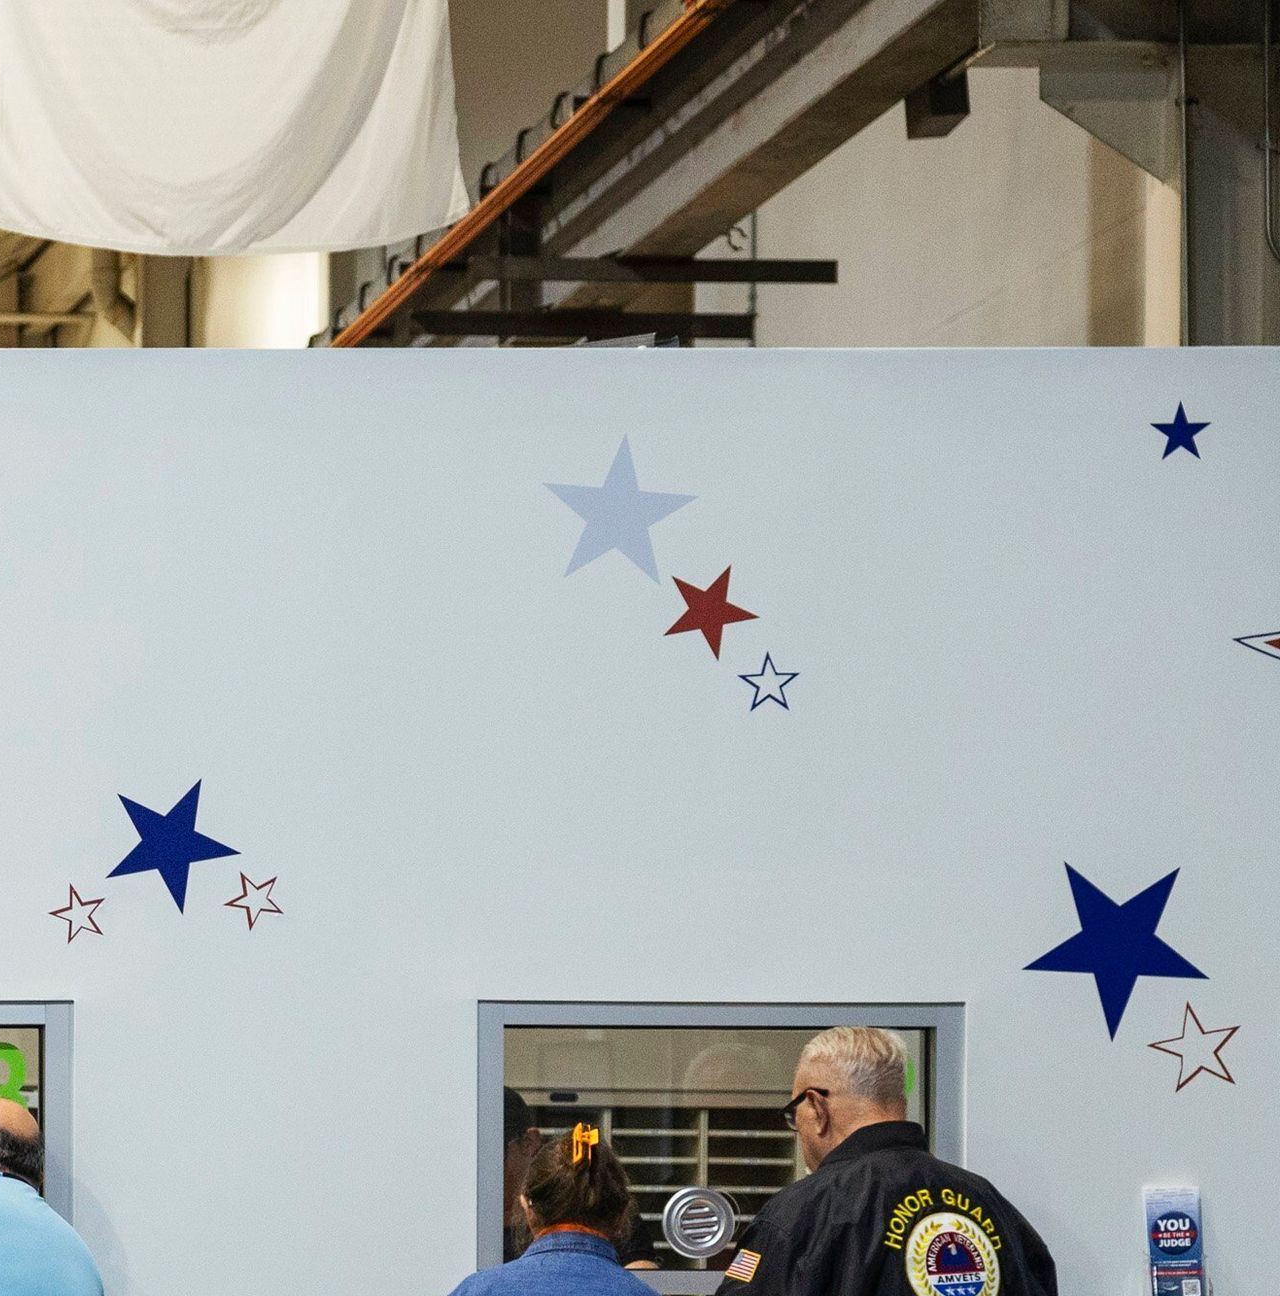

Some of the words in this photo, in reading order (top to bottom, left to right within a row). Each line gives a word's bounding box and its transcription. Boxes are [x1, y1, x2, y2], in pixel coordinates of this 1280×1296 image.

[884, 1189, 934, 1250] HONOR
[941, 1188, 1002, 1250] GUARD
[1157, 1218, 1190, 1231] YOU
[1163, 1231, 1171, 1239] BE
[1172, 1231, 1184, 1239] THE
[1158, 1237, 1192, 1248] JUDGE
[928, 1232, 952, 1272] AMERICAN
[937, 1272, 981, 1284] AMVETS
